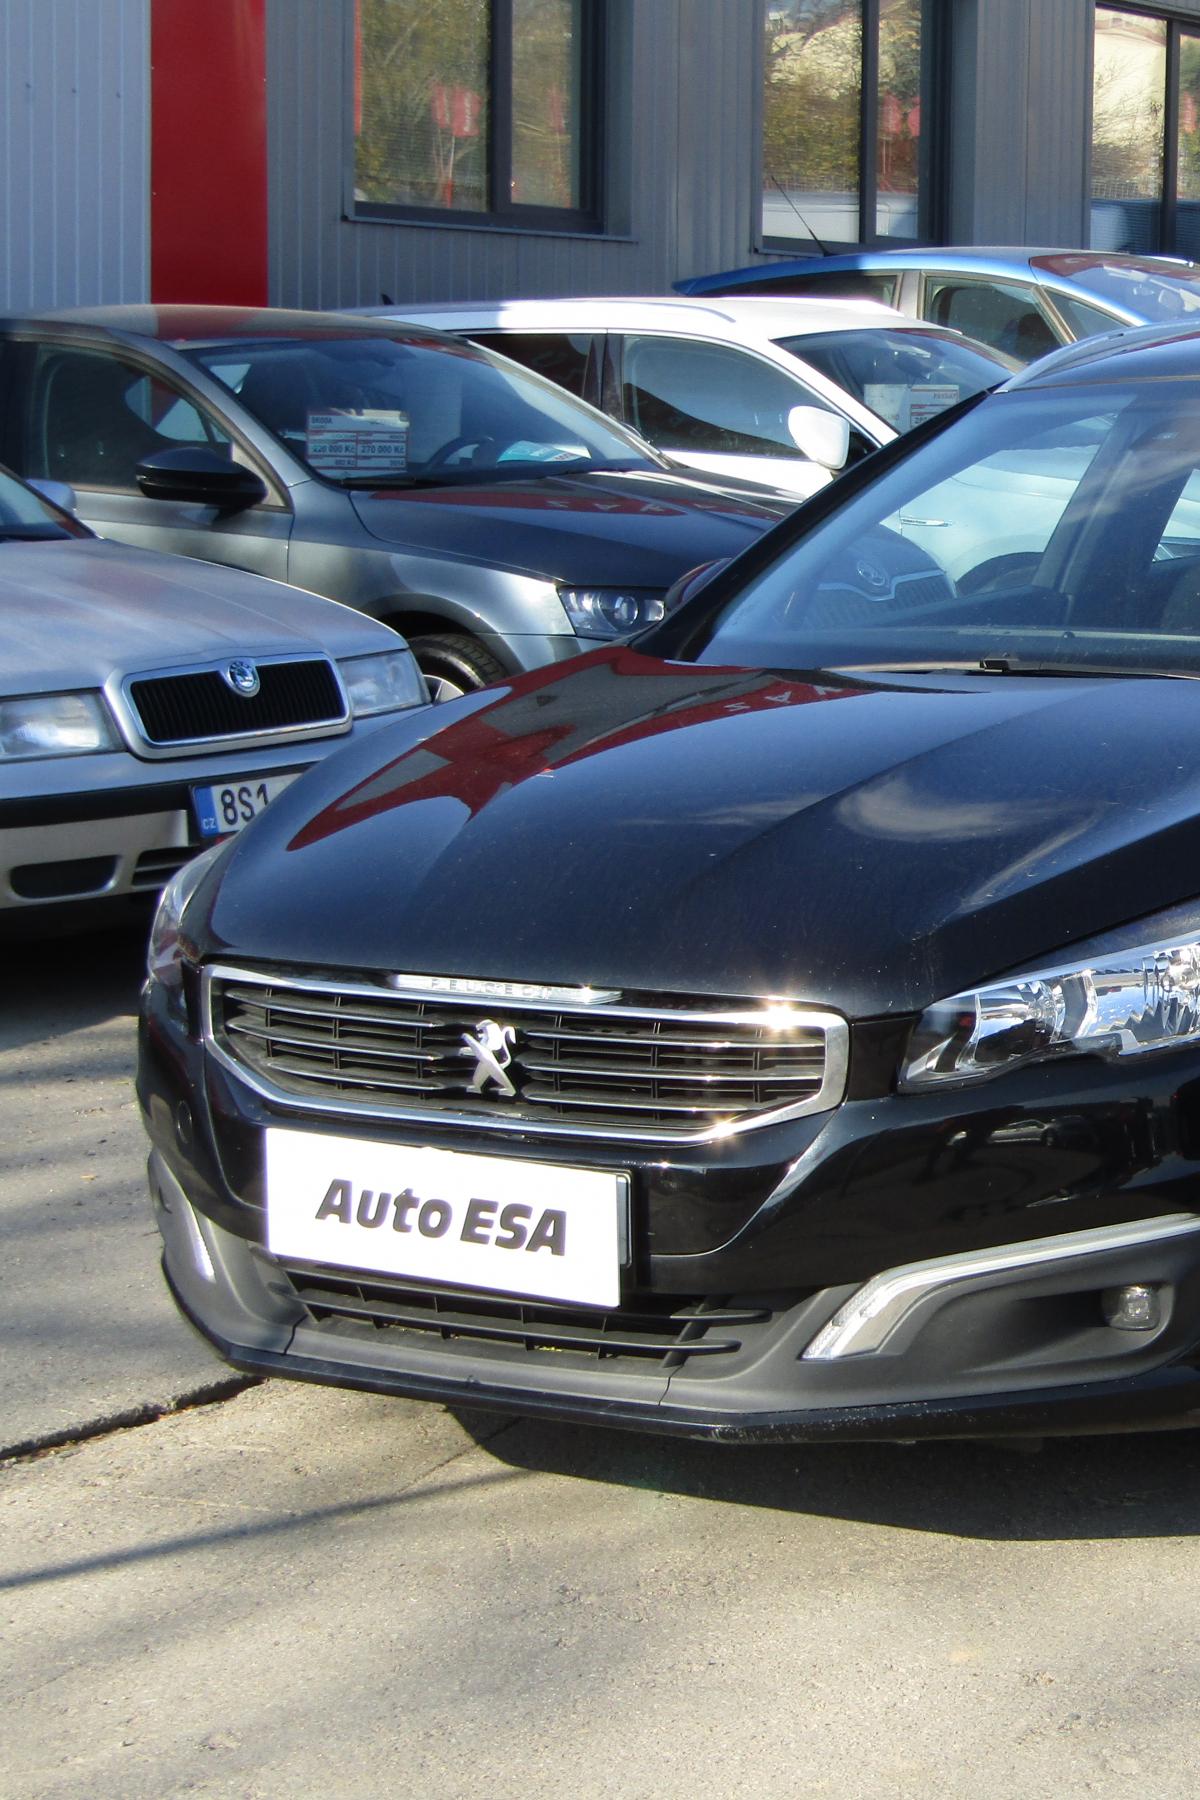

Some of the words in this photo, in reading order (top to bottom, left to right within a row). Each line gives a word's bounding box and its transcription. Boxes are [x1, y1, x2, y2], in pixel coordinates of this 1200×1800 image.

[361, 445, 376, 454] 270
[377, 445, 393, 454] 000
[221, 783, 268, 825] 8S1
[202, 817, 217, 830] CZ
[315, 1178, 453, 1239] Auto
[460, 1198, 567, 1256] ESA
